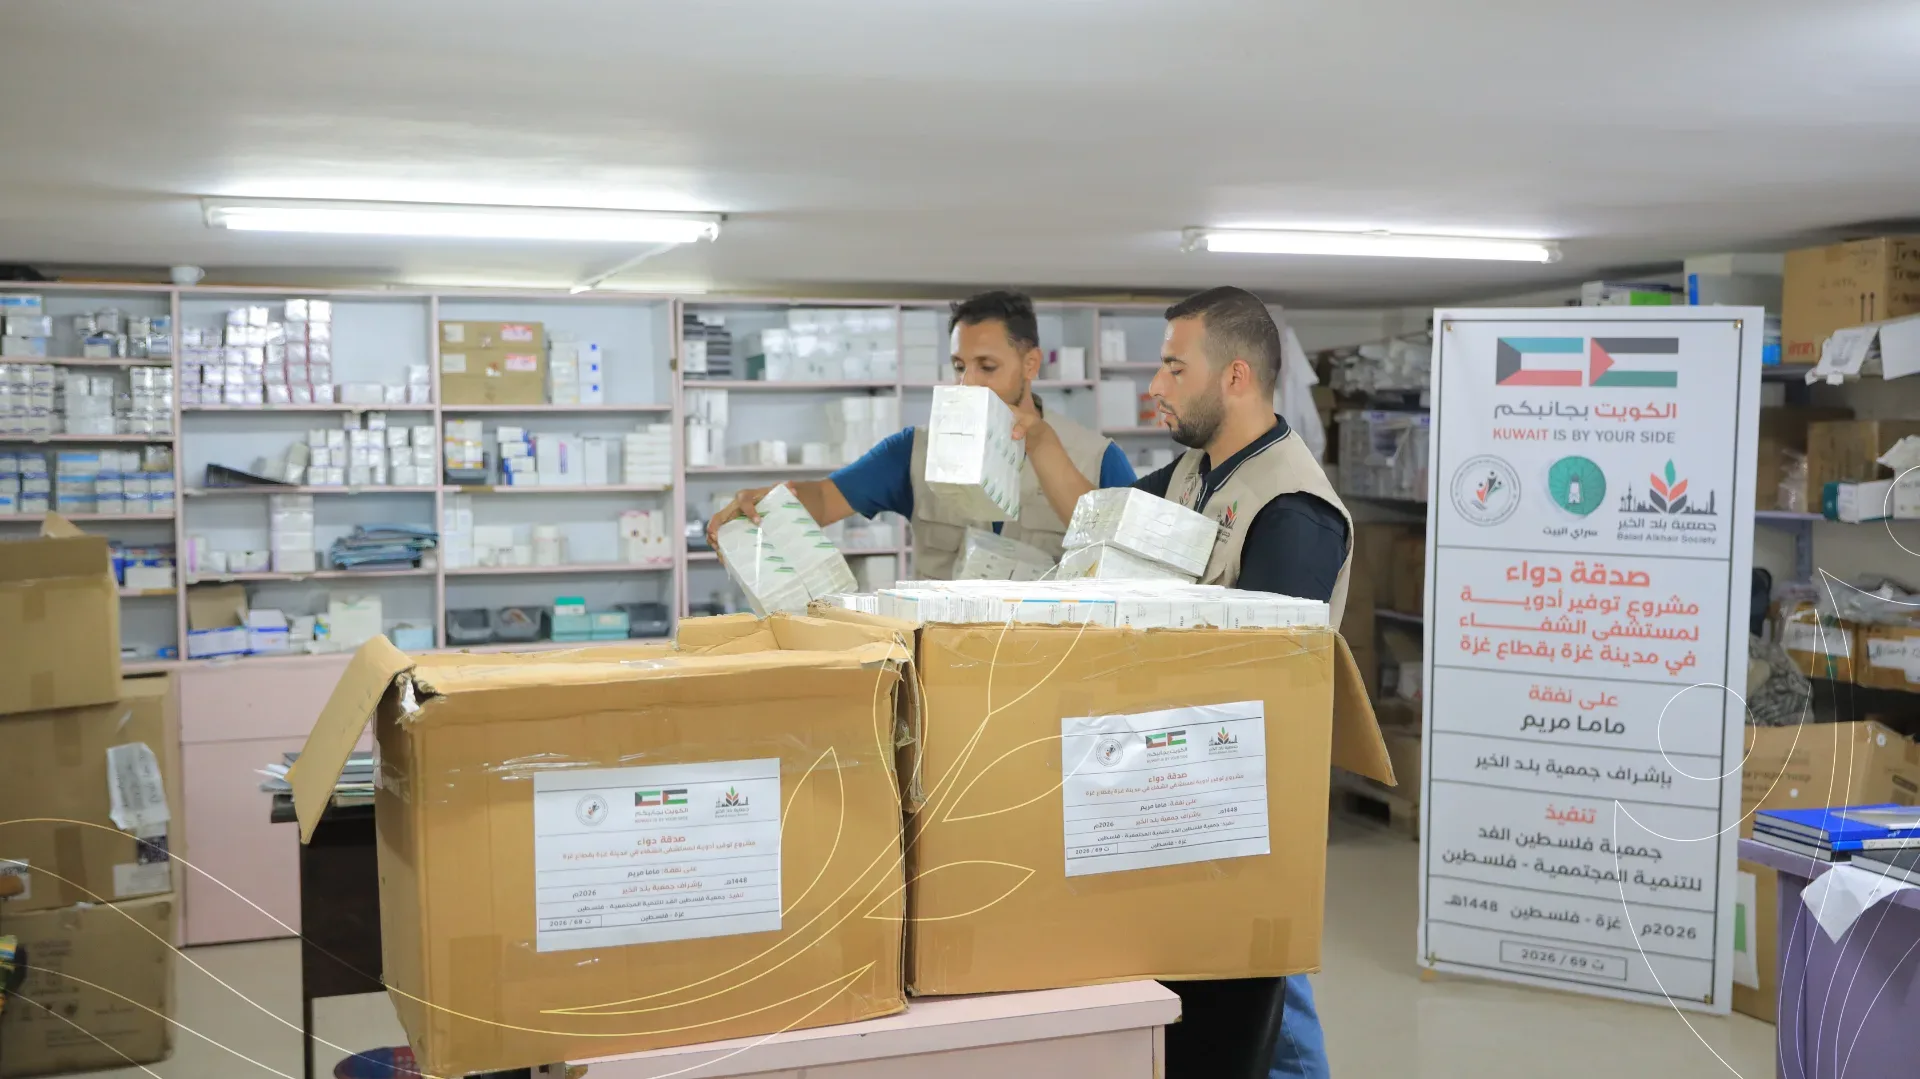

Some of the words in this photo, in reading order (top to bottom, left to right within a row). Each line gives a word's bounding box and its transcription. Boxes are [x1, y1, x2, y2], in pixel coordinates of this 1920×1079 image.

[1494, 401, 1589, 421] بجانبكم
[1594, 402, 1677, 423] الكويت
[1493, 428, 1549, 441] KUWAIT
[1553, 429, 1566, 441] IS
[1572, 430, 1590, 442] BY
[1597, 430, 1635, 443] YOUR
[1640, 431, 1676, 444] SIDE
[1542, 526, 1568, 536] البيت
[1570, 528, 1598, 539] سراي
[1618, 517, 1645, 531] الخير
[1649, 517, 1667, 530] بلد
[1672, 518, 1717, 532] جمعية
[1682, 534, 1717, 545] Society
[1506, 560, 1562, 587] دواء
[1570, 560, 1650, 587] صدقة
[1568, 594, 1620, 615] توفير
[1626, 595, 1699, 621] مشروع
[1592, 617, 1699, 642] لمستشفى
[1460, 635, 1491, 655] غزة
[1496, 640, 1555, 664] بقطاع
[1560, 642, 1593, 664] غزة
[1599, 644, 1659, 668] مدينة
[1665, 650, 1696, 676] في
[1529, 684, 1573, 703] نفقة
[1579, 689, 1619, 710] على
[1520, 713, 1570, 734] مريم
[1577, 715, 1626, 735] ماما
[1474, 753, 1510, 771] الخير
[1514, 756, 1540, 776] بلد
[1545, 758, 1601, 782] جمعية
[1148, 775, 1165, 783] دواء
[1167, 772, 1187, 780] صدقة
[1607, 766, 1673, 790] بإشراف
[1545, 803, 1597, 826] تنفيذ
[637, 837, 657, 847] دواء
[660, 835, 686, 844] صدقة
[1477, 825, 1511, 842] الغد
[1515, 830, 1594, 852] فلسطين
[1442, 849, 1516, 870] فلسطين
[1600, 839, 1662, 861] جمعية
[627, 870, 644, 878] مريم
[1534, 858, 1628, 886] المجتمعية
[1634, 868, 1702, 892] للتنمية
[1510, 908, 1581, 925] فلسطين
[1595, 914, 1622, 932] غزة
[1521, 948, 1556, 963] 2026
[1569, 956, 1587, 969] 69
